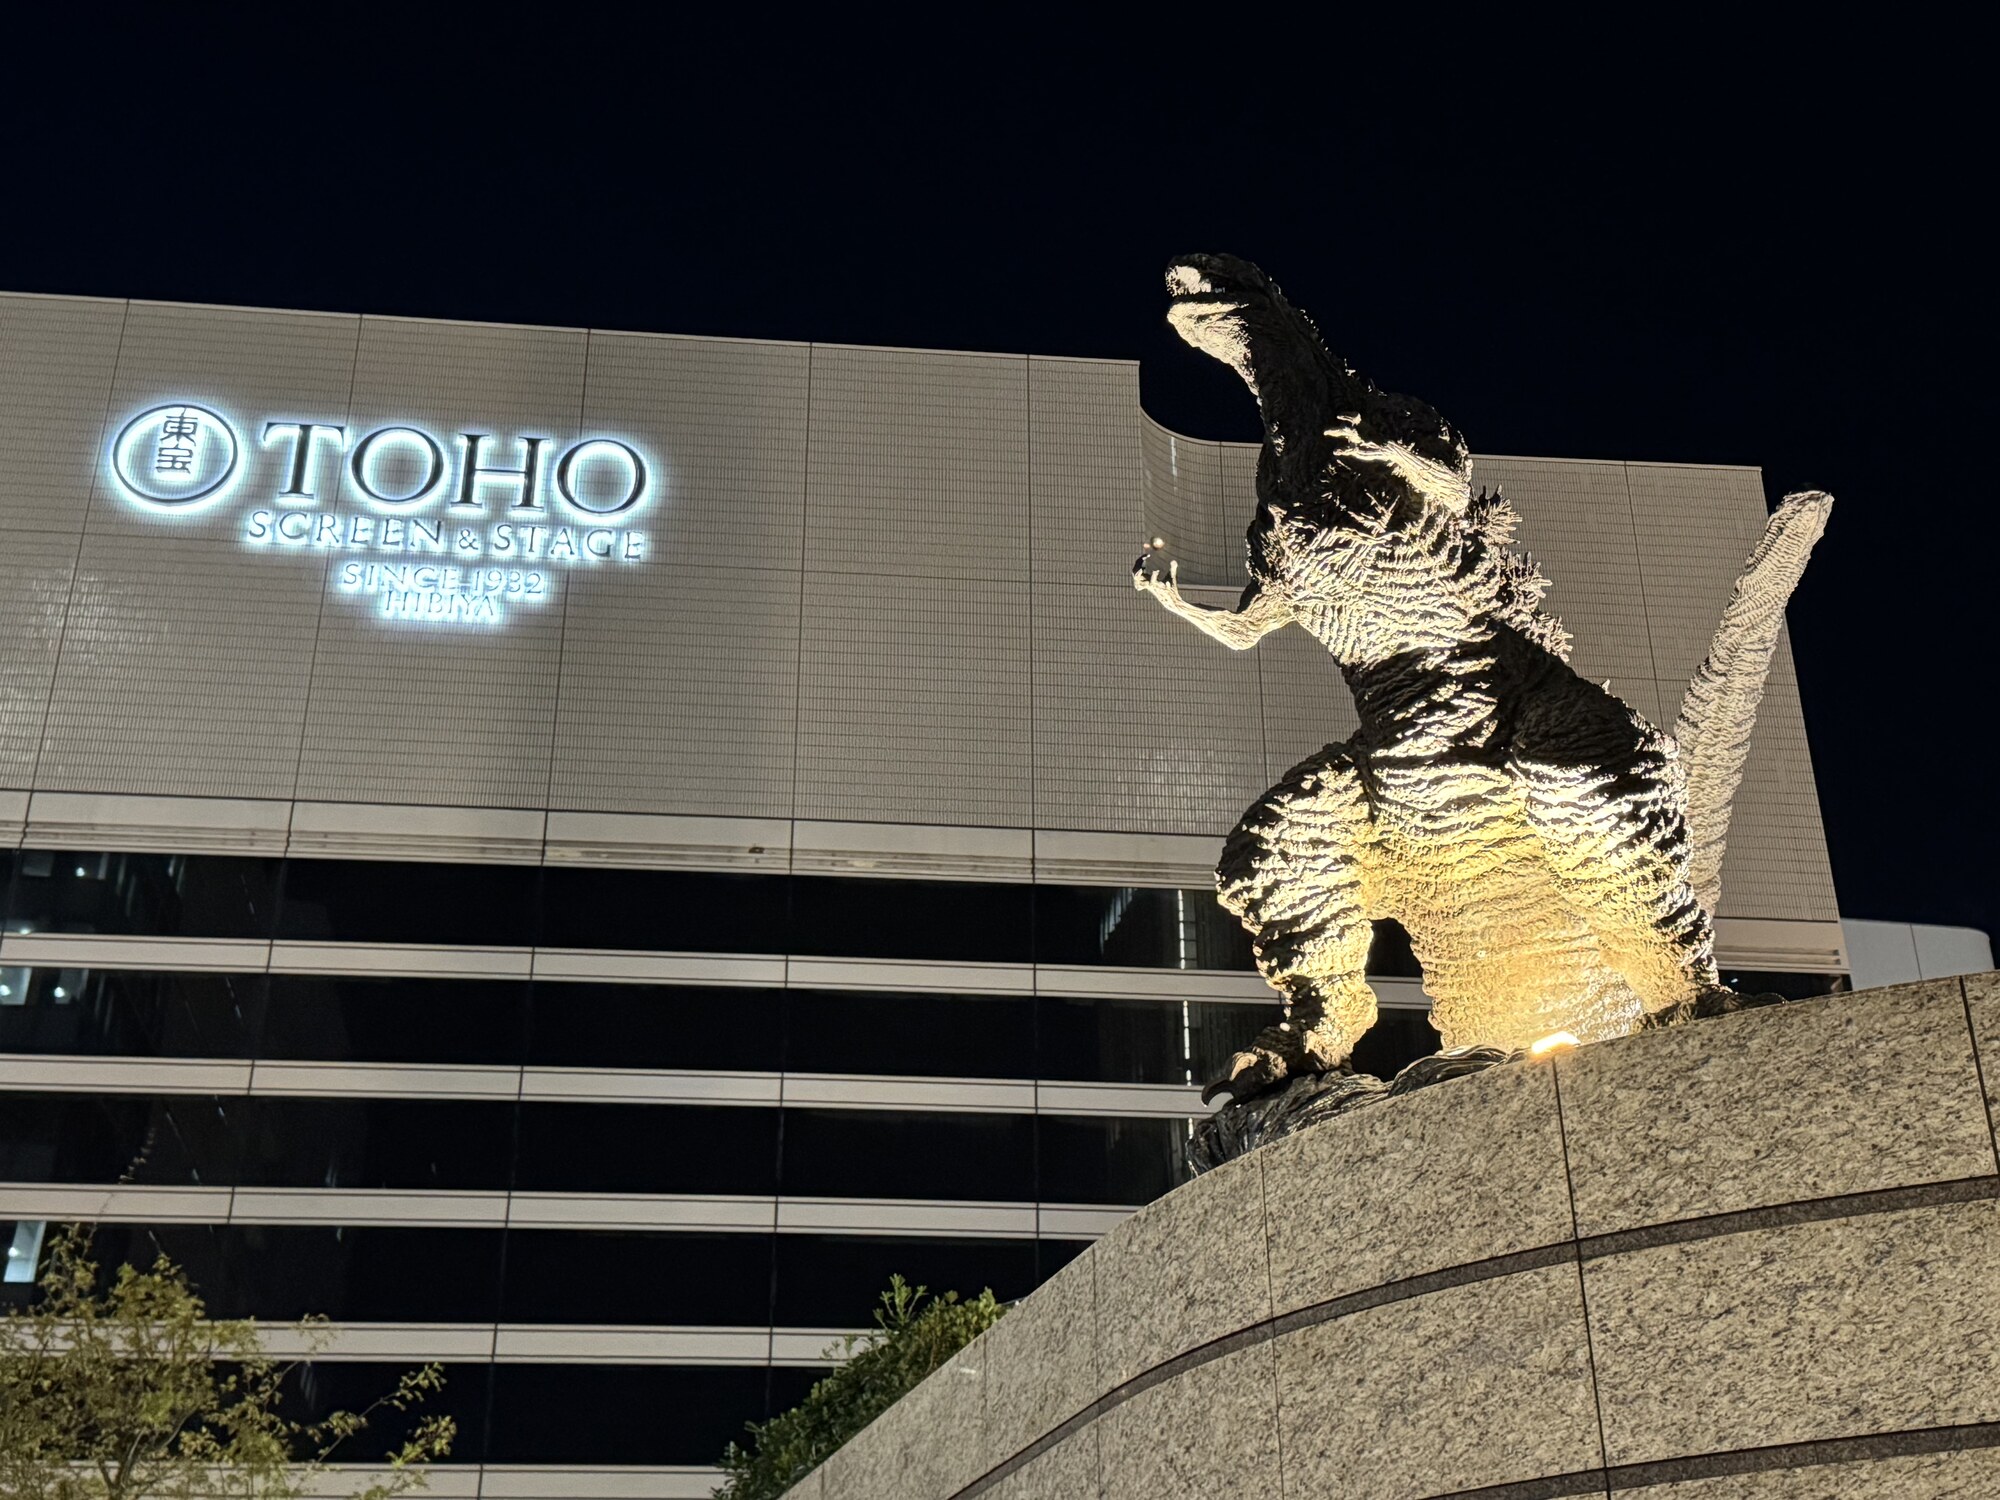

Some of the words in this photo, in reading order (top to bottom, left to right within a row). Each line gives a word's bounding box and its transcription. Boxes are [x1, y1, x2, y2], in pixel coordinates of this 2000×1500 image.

[262, 420, 648, 515] TOHO
[246, 510, 444, 549] SCREEN
[457, 528, 480, 551] &
[493, 523, 646, 561] STAGE
[342, 562, 459, 592] SINCE
[475, 570, 543, 594] 1932
[384, 589, 495, 617] HIBIYA
